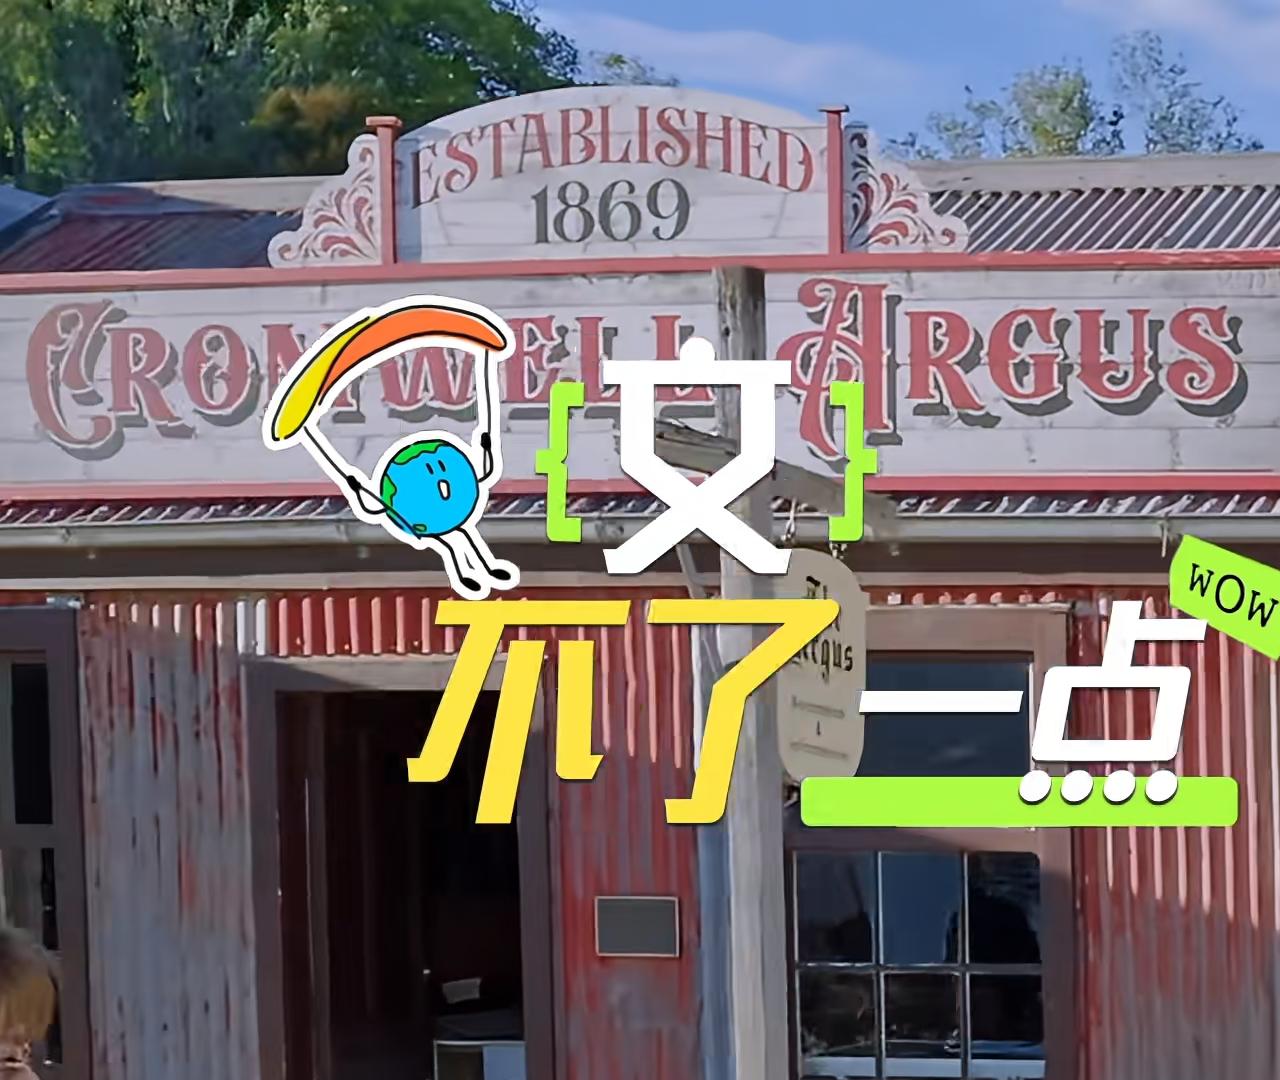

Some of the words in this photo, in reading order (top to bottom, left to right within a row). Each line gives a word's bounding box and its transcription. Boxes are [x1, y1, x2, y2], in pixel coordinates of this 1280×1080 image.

[411, 104, 815, 209] ESTABLISHED
[531, 177, 691, 245] 1869
[775, 276, 1246, 460] ARGUS
